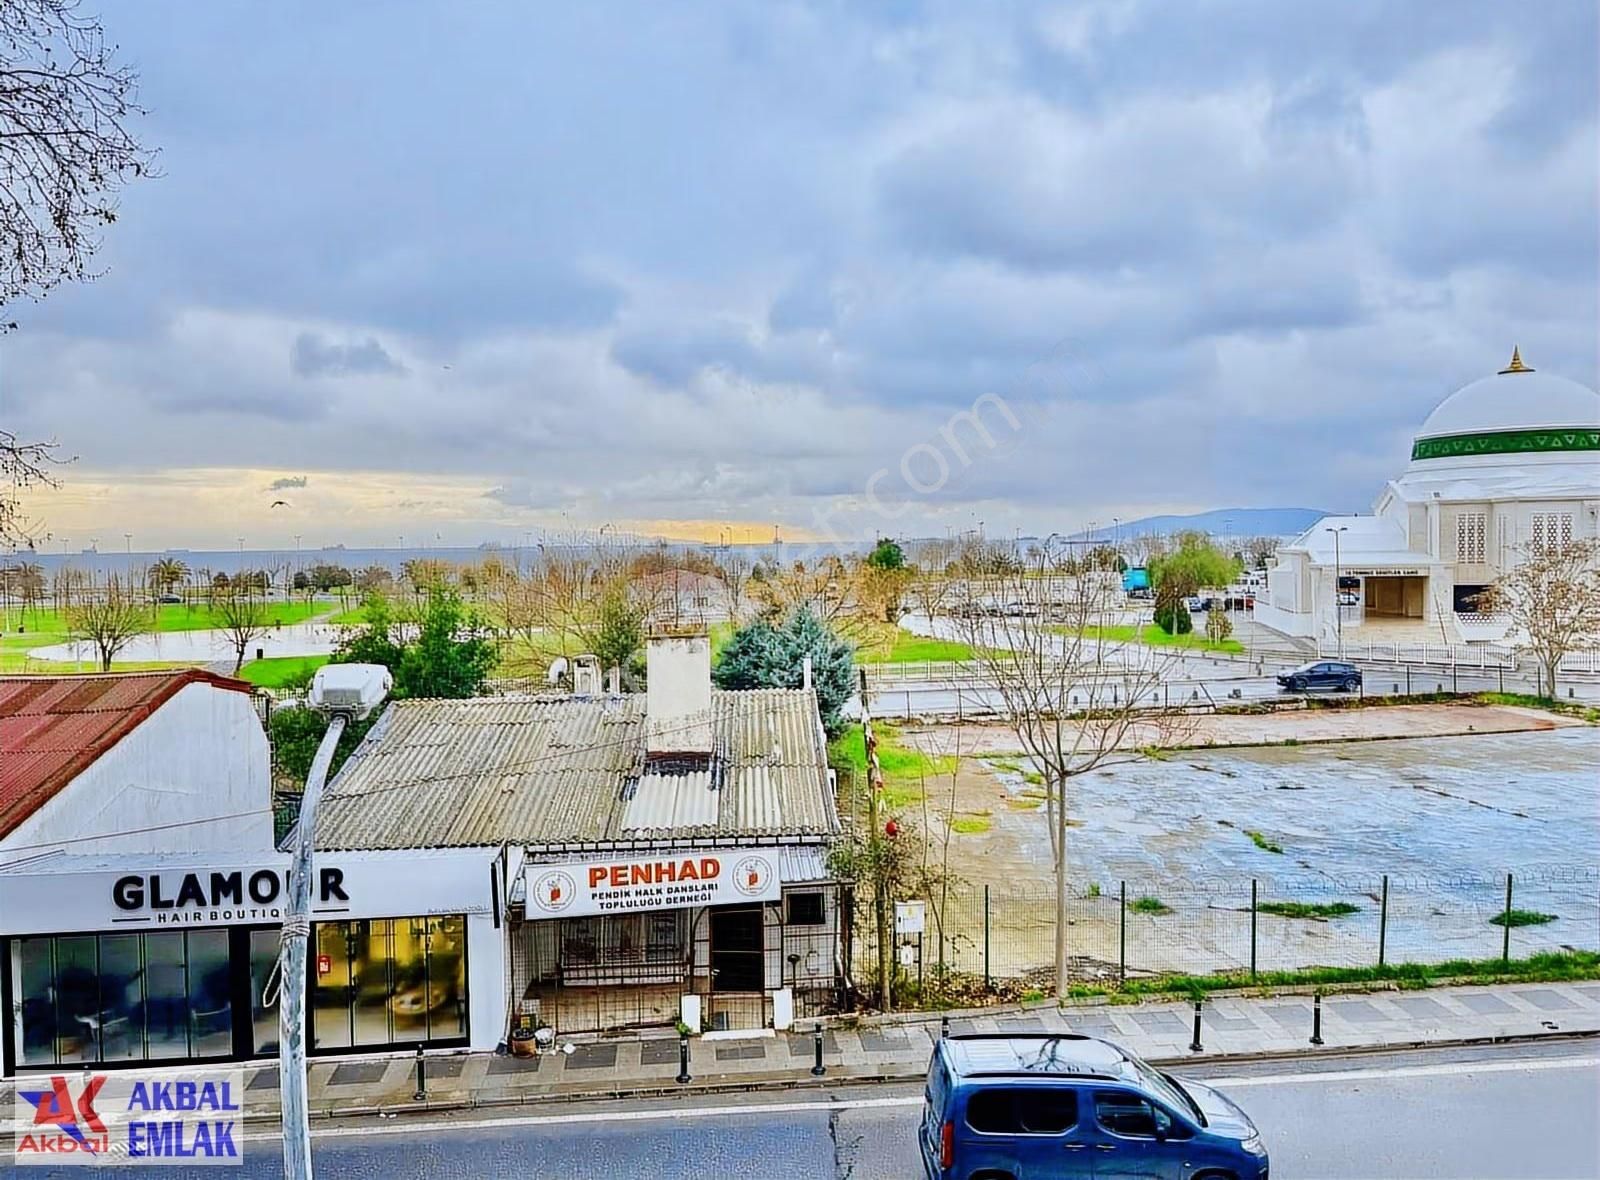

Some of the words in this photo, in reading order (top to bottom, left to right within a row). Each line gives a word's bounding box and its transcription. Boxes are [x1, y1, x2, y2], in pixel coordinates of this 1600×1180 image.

[589, 858, 721, 888] PENHAD
[113, 867, 350, 910] GLAMOR
[591, 890, 631, 901] PENDİK
[634, 887, 664, 897] HALK
[666, 883, 720, 895] DANSLARI
[157, 911, 203, 923] HAIR
[209, 908, 287, 921] BOUTIQ
